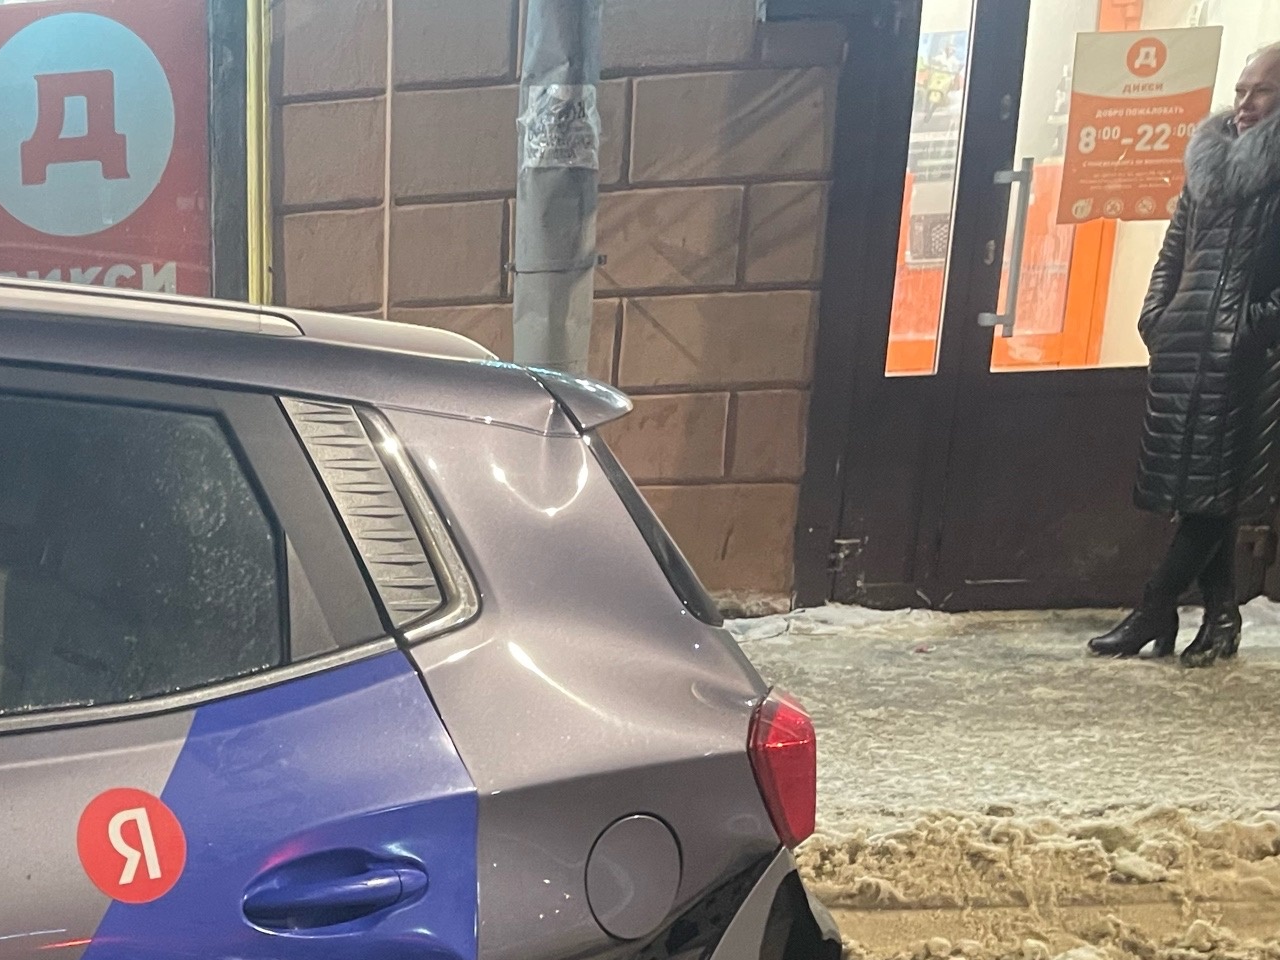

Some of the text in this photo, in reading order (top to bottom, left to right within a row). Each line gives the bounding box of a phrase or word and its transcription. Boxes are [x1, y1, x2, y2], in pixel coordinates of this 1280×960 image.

[1133, 46, 1157, 69] Д
[1122, 82, 1164, 94] ДИКСИ
[20, 69, 131, 186] Д
[108, 807, 162, 885] Я
